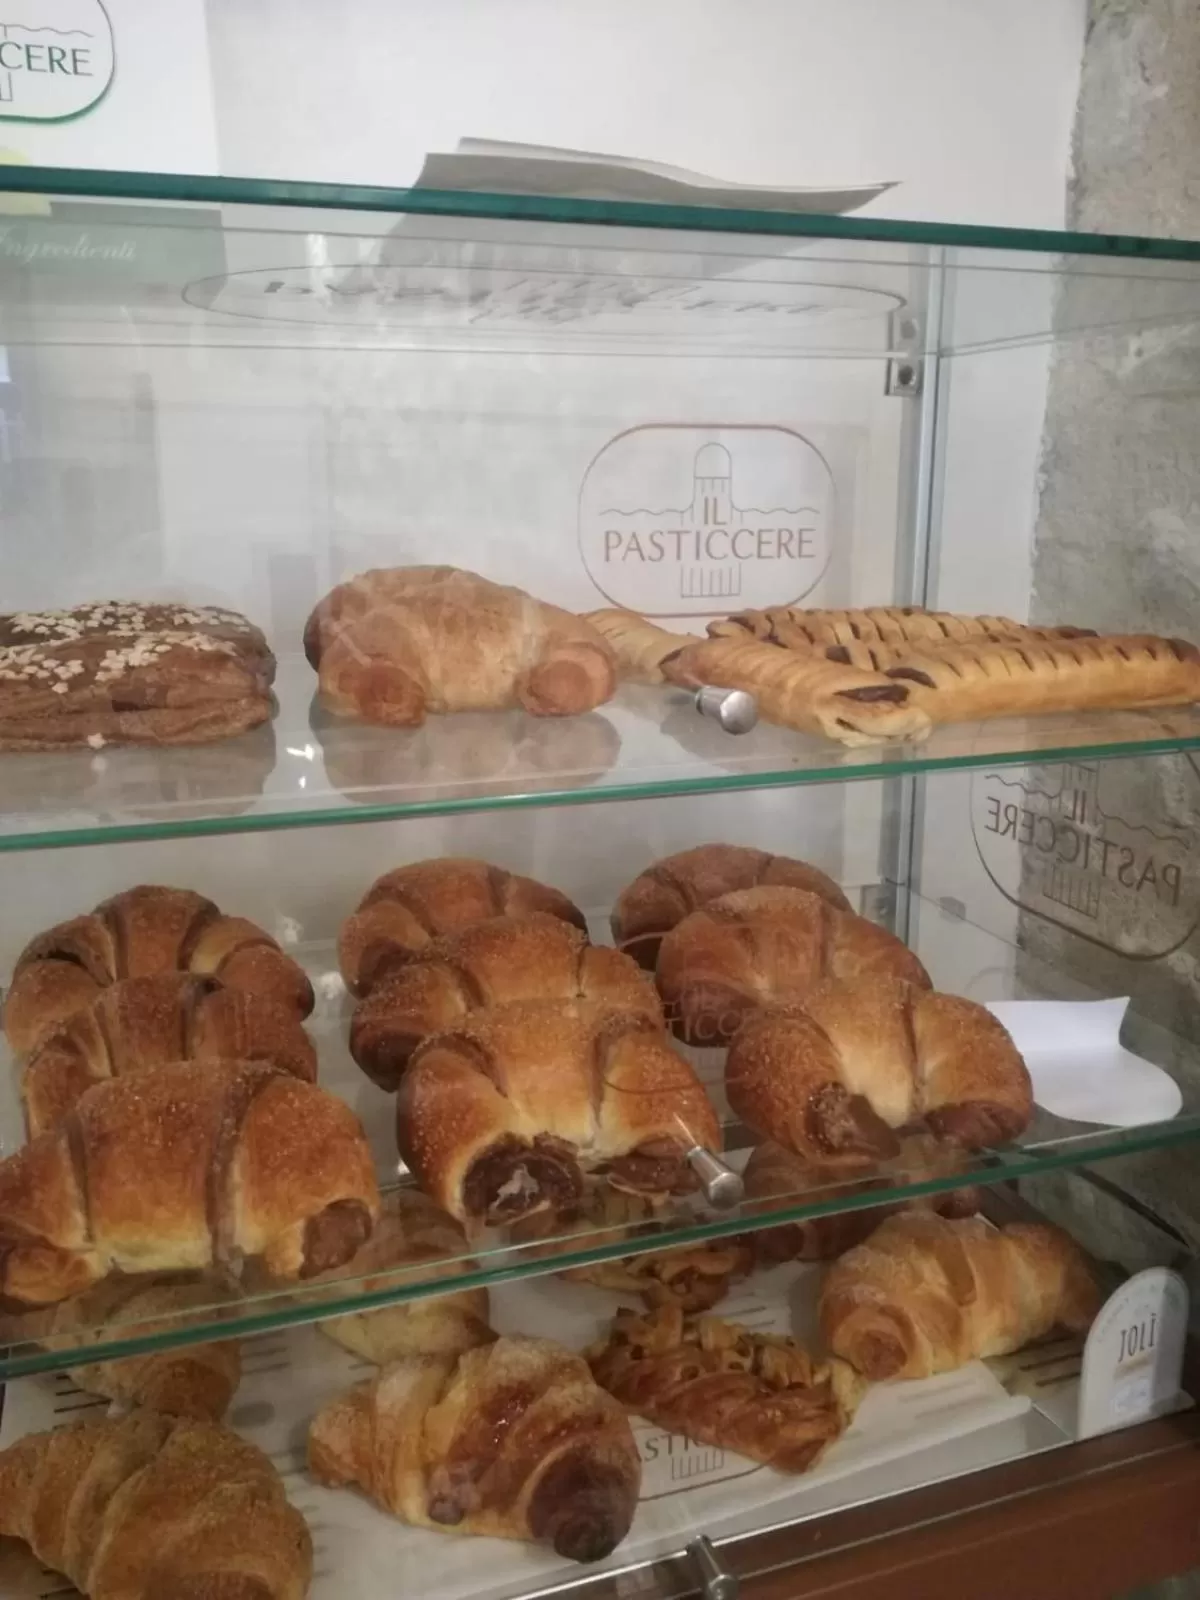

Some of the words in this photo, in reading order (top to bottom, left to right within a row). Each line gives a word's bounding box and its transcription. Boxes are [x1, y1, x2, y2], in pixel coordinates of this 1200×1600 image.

[0, 41, 94, 76] CERE
[703, 496, 727, 526] IL
[604, 528, 816, 562] PASTICCERE
